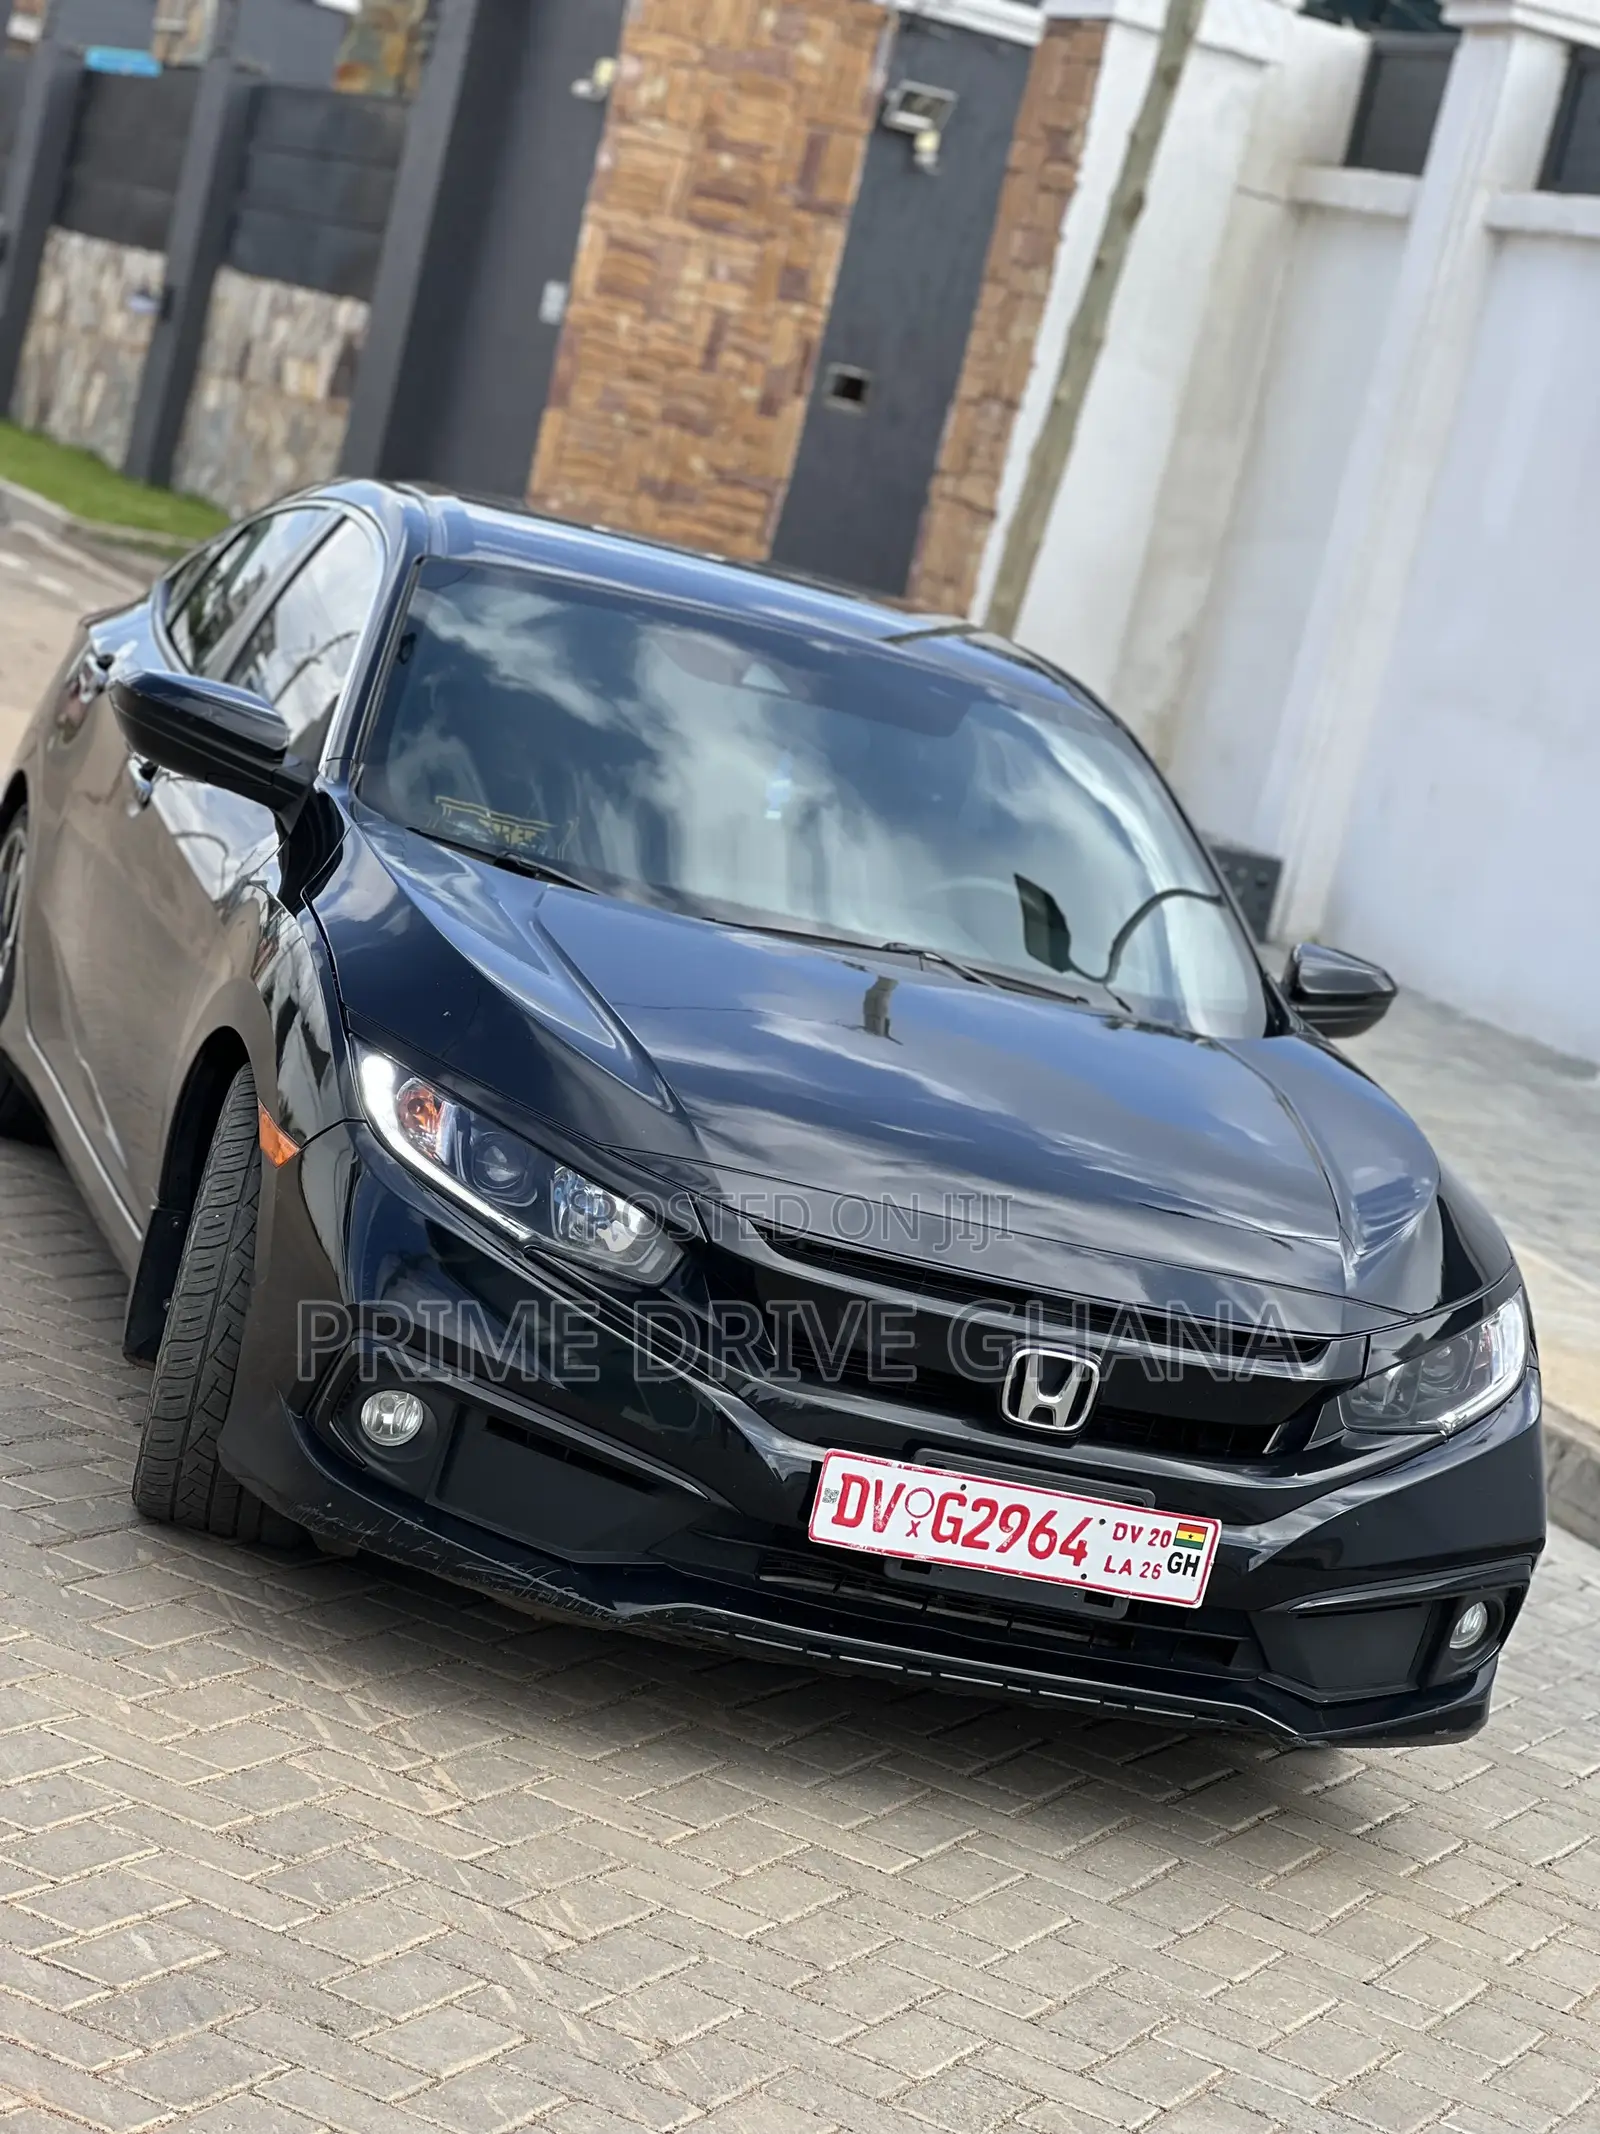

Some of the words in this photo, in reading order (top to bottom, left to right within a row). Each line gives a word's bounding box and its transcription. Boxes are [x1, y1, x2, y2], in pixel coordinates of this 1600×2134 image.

[831, 1472, 906, 1533] DV
[931, 1491, 1093, 1567] G2964
[1112, 1522, 1144, 1543] DV
[1147, 1527, 1173, 1548] 20
[1103, 1554, 1132, 1576] LA
[1139, 1561, 1162, 1580] 26
[1167, 1551, 1201, 1577] GH
